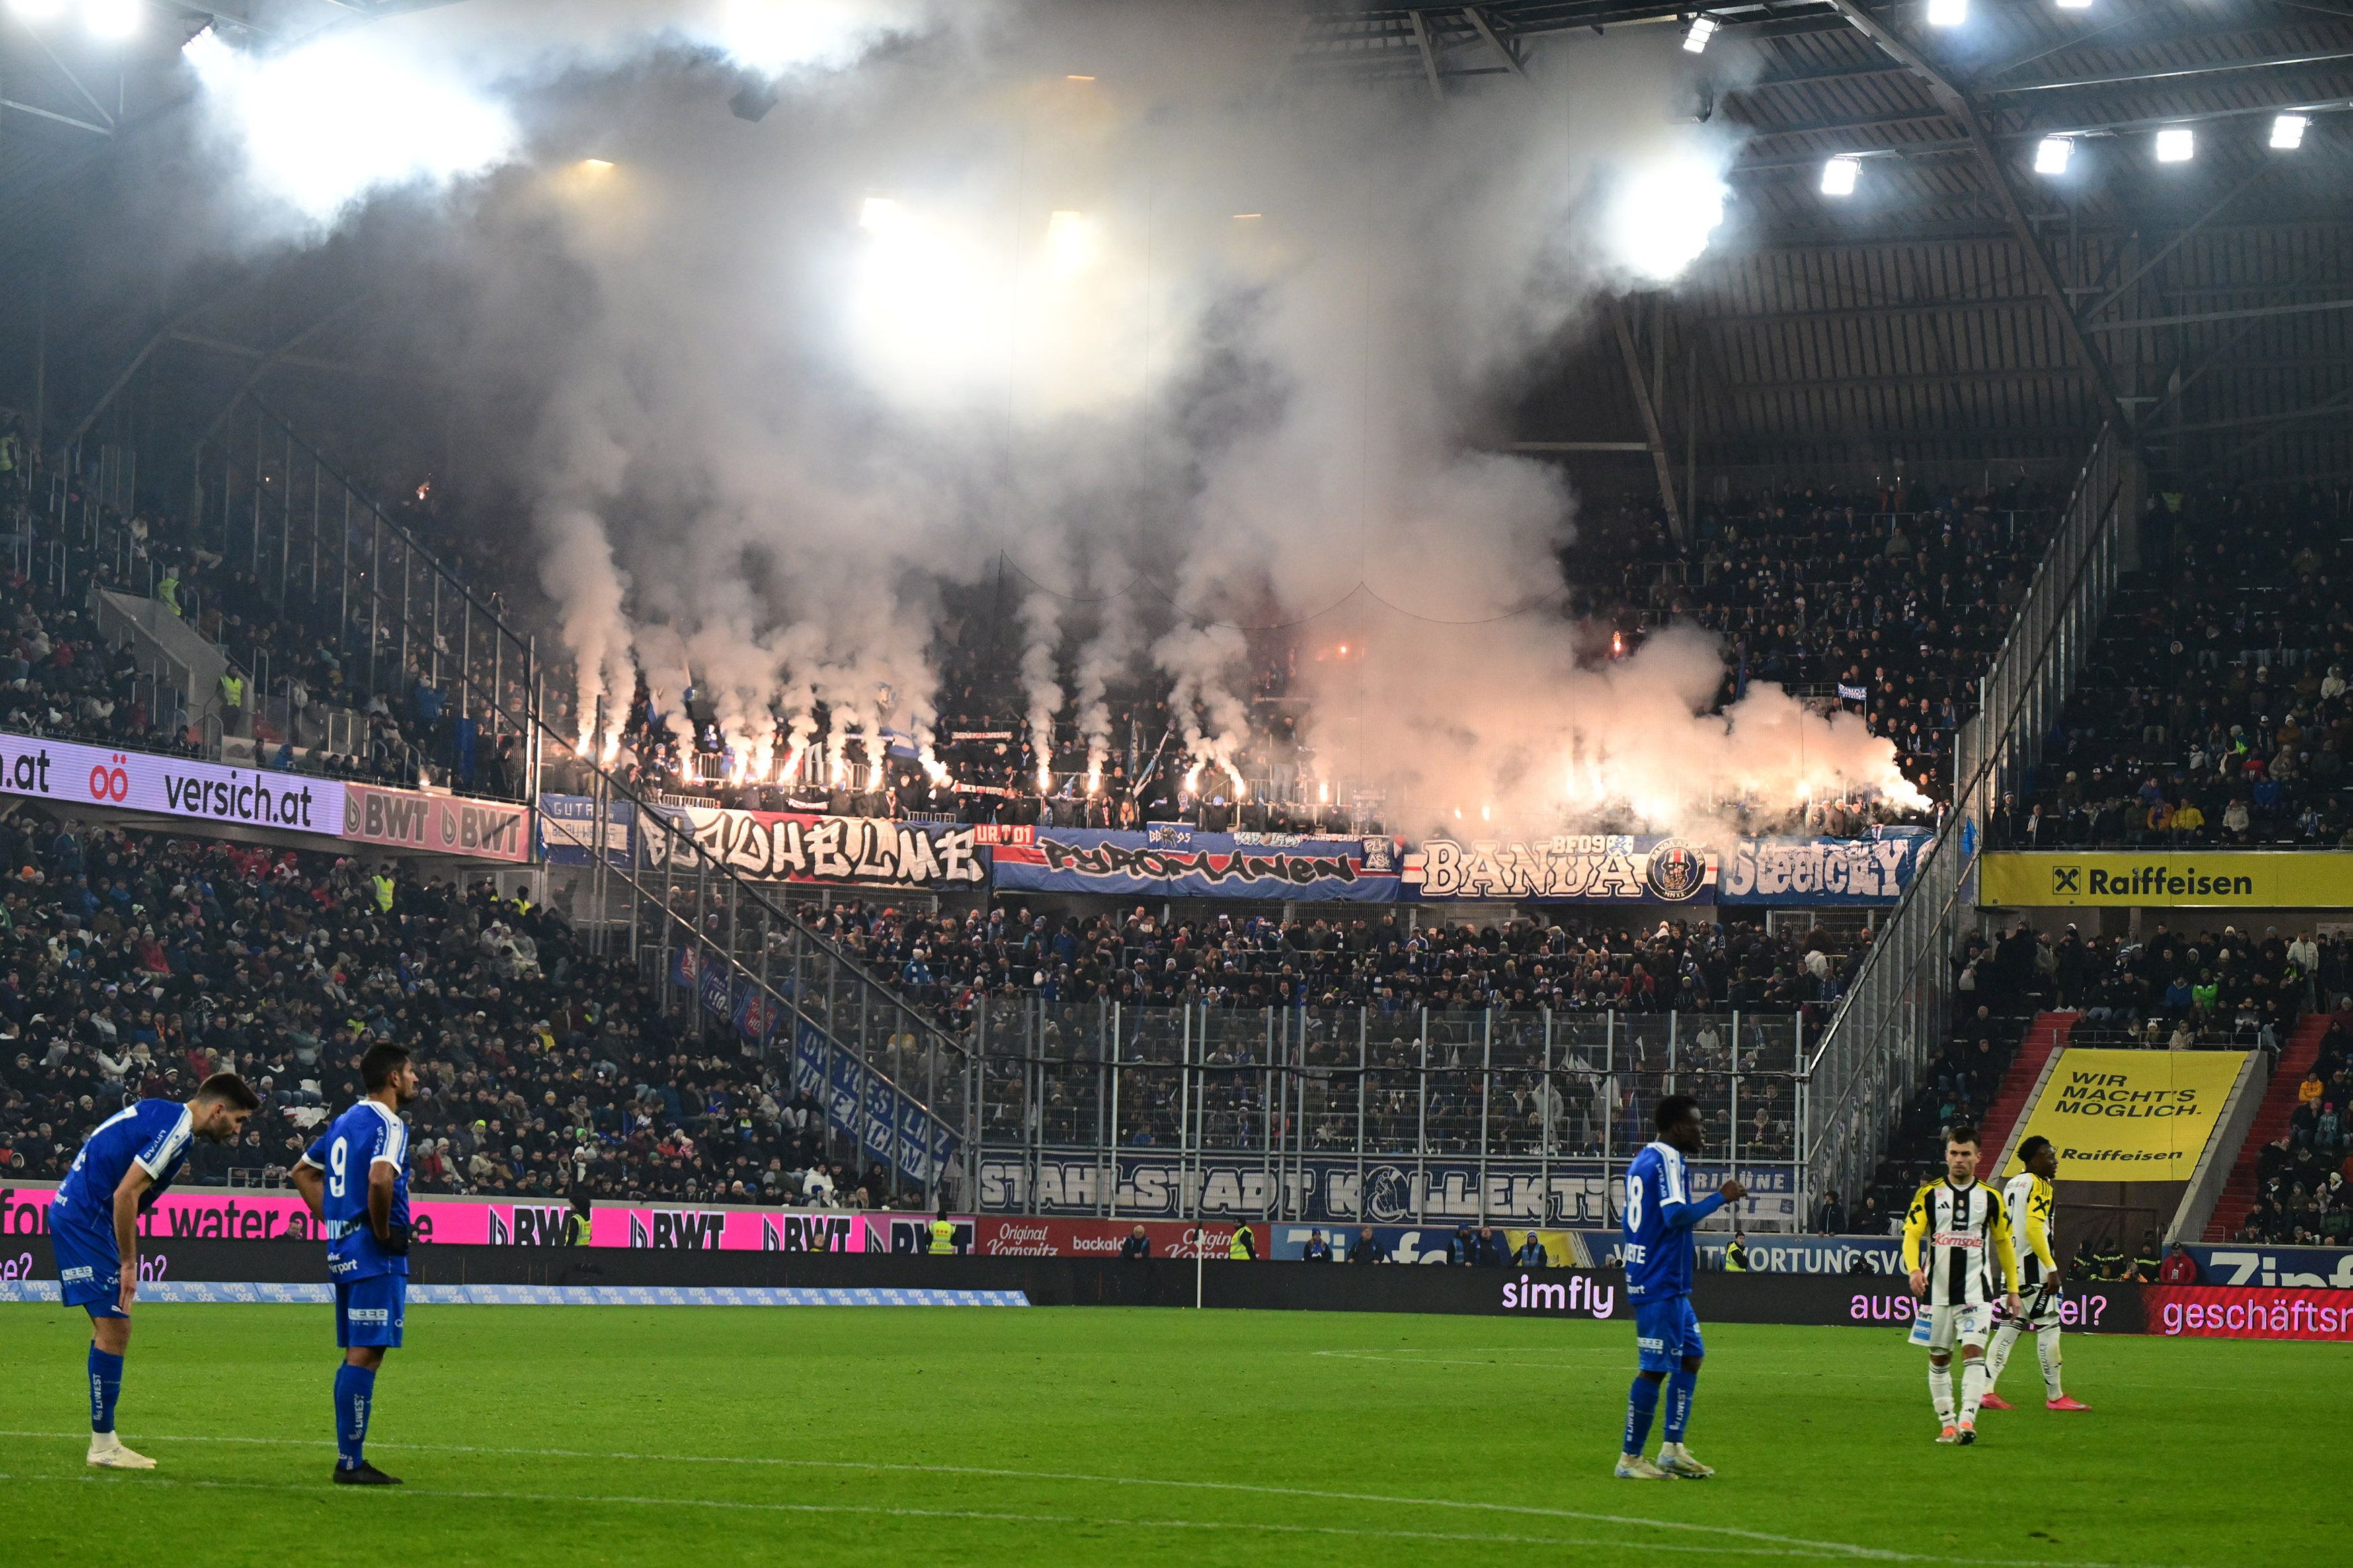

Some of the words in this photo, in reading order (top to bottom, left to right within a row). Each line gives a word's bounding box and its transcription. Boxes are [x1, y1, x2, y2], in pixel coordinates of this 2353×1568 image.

[0, 749, 50, 793] .at
[165, 770, 312, 827] versich.at
[362, 794, 430, 844] BWT
[457, 808, 522, 855] BWT
[2089, 866, 2252, 895] Raiffeisen
[2072, 1071, 2127, 1087] WIR
[2062, 1085, 2196, 1103] MACHT'S
[2054, 1099, 2202, 1118] MÖGLICH.
[2061, 1148, 2183, 1161] Raiffeisen
[329, 1136, 348, 1198] 9
[981, 1165, 1314, 1210] STAHLSTADT
[169, 1199, 278, 1239] water
[513, 1205, 570, 1246] BW
[653, 1210, 725, 1249] BWT
[783, 1213, 851, 1253] BWT
[890, 1219, 974, 1255] BT
[1000, 1223, 1048, 1248] Original
[1074, 1235, 1126, 1251] backald
[1183, 1229, 1232, 1251] Oigin
[1932, 1233, 1983, 1249] Kornspitz
[25, 1282, 50, 1291] HYPO
[147, 1284, 170, 1292] HYPO
[182, 1284, 206, 1292] HYPO
[221, 1284, 245, 1292] HYPO
[262, 1284, 284, 1293] HYPO
[298, 1284, 319, 1293] HYPO
[407, 1286, 420, 1294] PO
[1501, 1274, 1613, 1318] simfly
[1638, 1337, 1663, 1347] EEB
[93, 1373, 104, 1409] LIWEST
